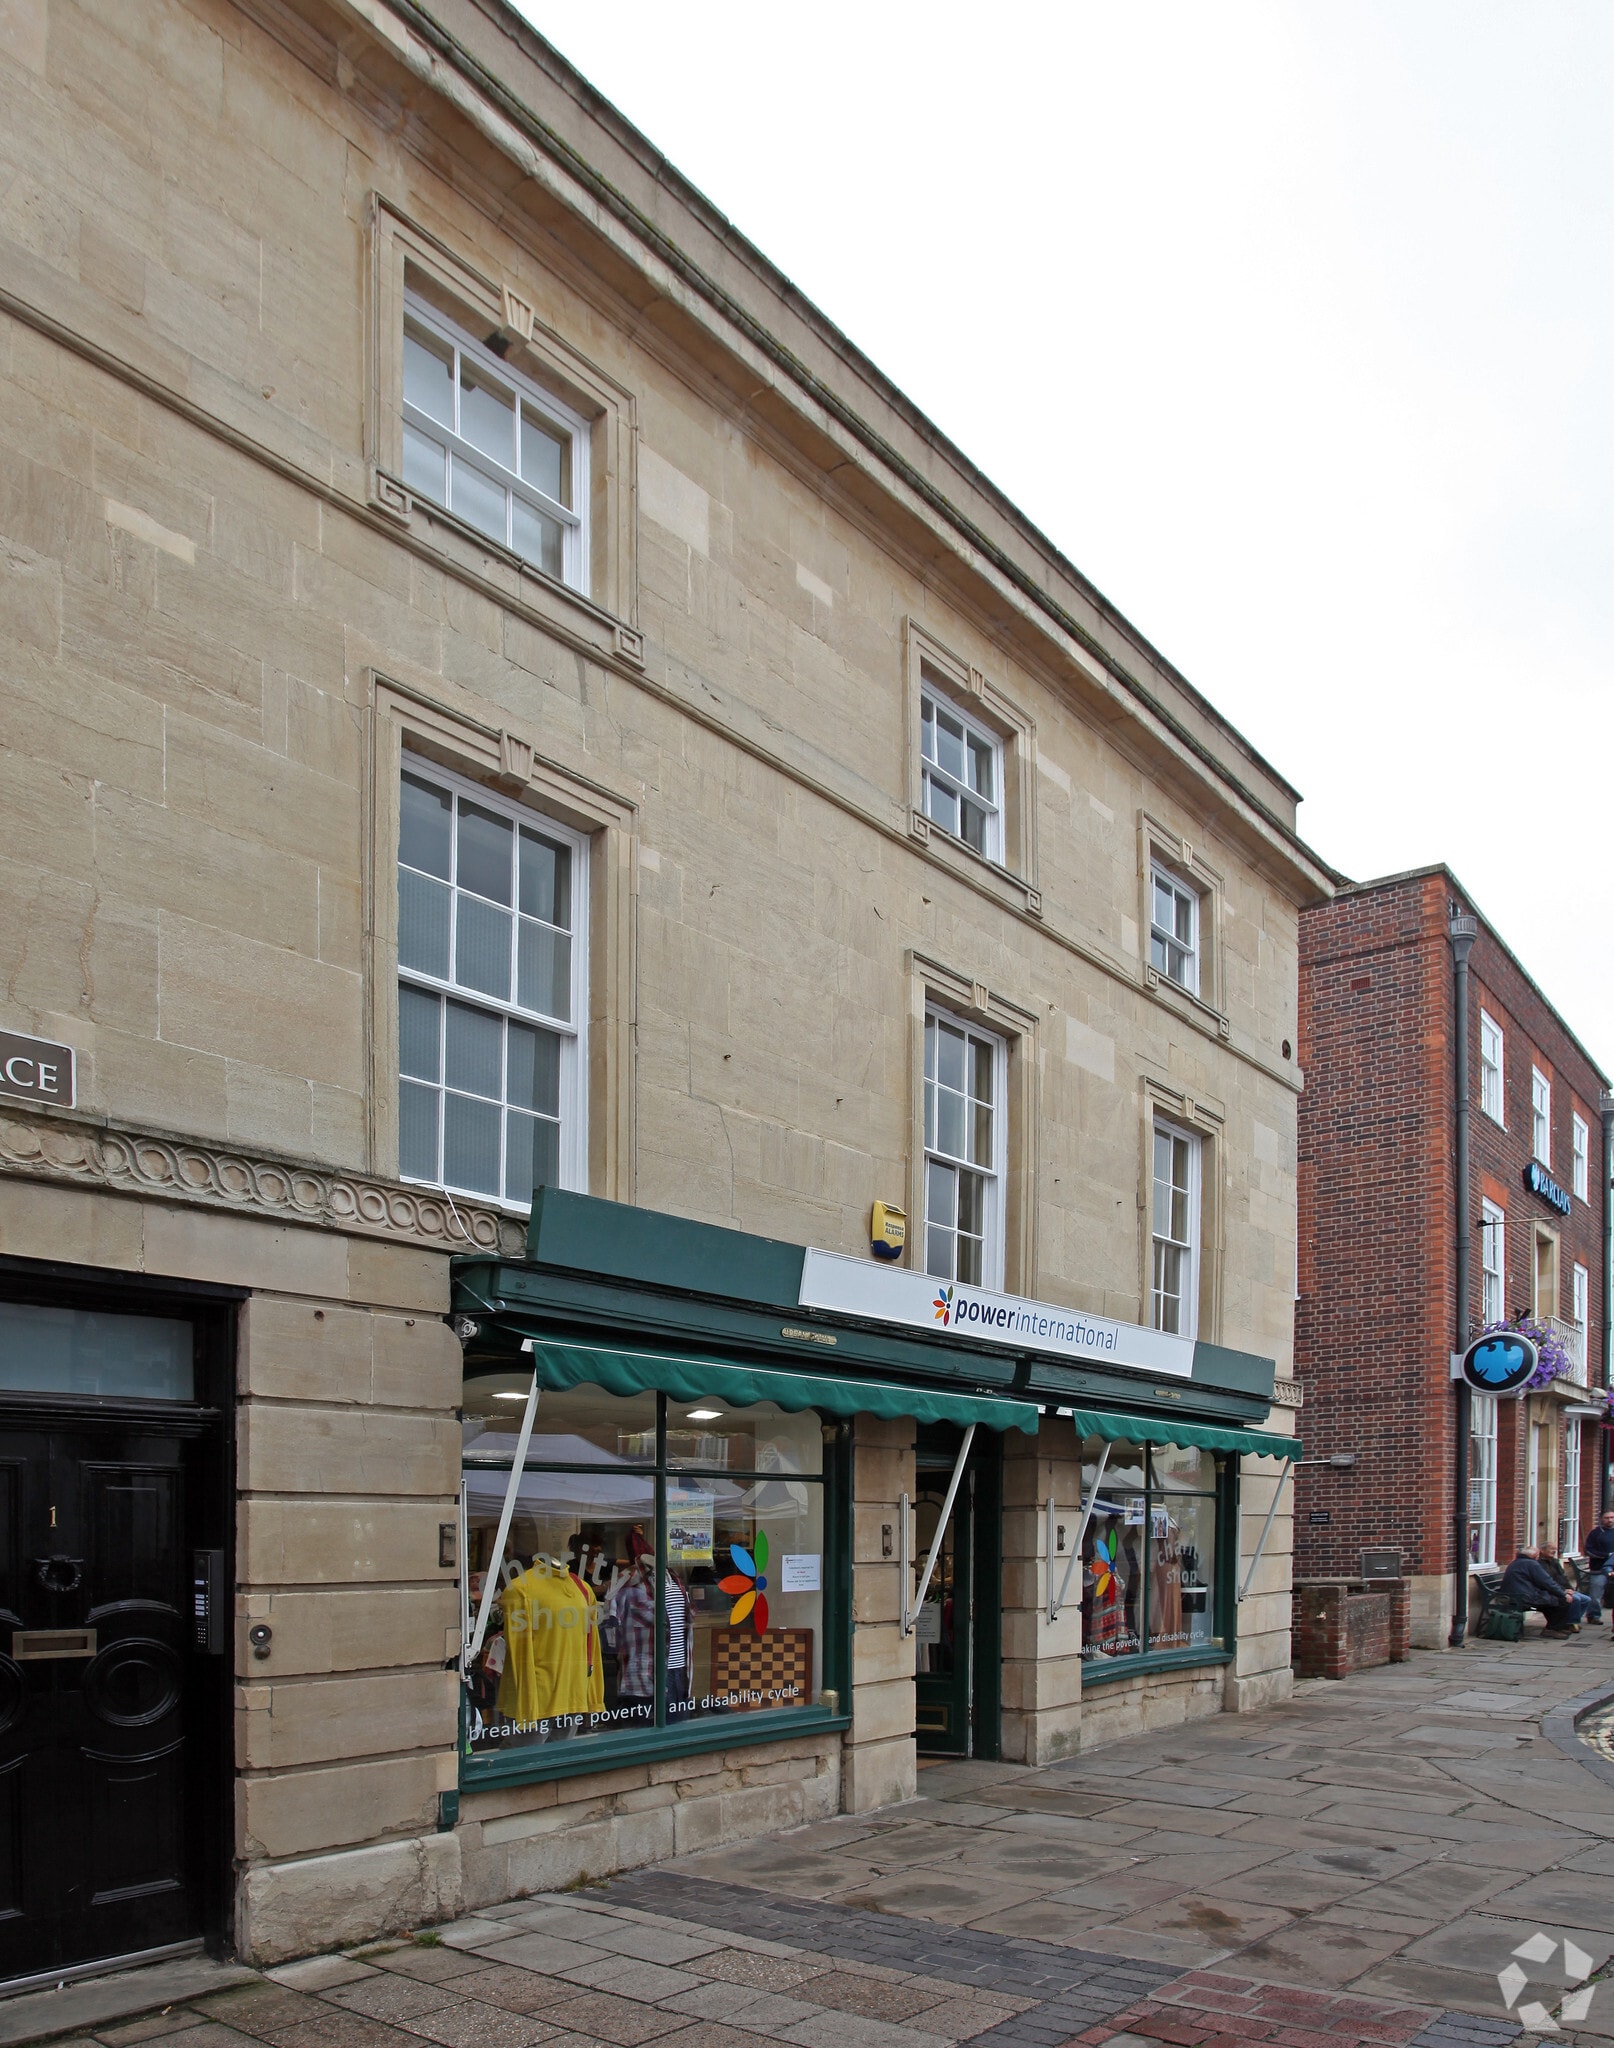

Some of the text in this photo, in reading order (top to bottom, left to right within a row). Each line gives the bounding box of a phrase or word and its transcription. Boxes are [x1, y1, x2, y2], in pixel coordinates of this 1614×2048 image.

[0, 1056, 59, 1094] CE
[1540, 1171, 1571, 1216] BARCLAYS
[885, 1227, 904, 1238] ALARMS
[955, 1298, 1119, 1350] powerinternational
[48, 1505, 58, 1528] 1
[1166, 1567, 1198, 1587] shop
[510, 1599, 604, 1634] shop
[1102, 1641, 1114, 1651] the
[1115, 1637, 1142, 1651] poverty
[1148, 1633, 1161, 1644] and
[1161, 1630, 1188, 1643] disability
[468, 1684, 799, 1742] breaking the poverty and disability cycle
